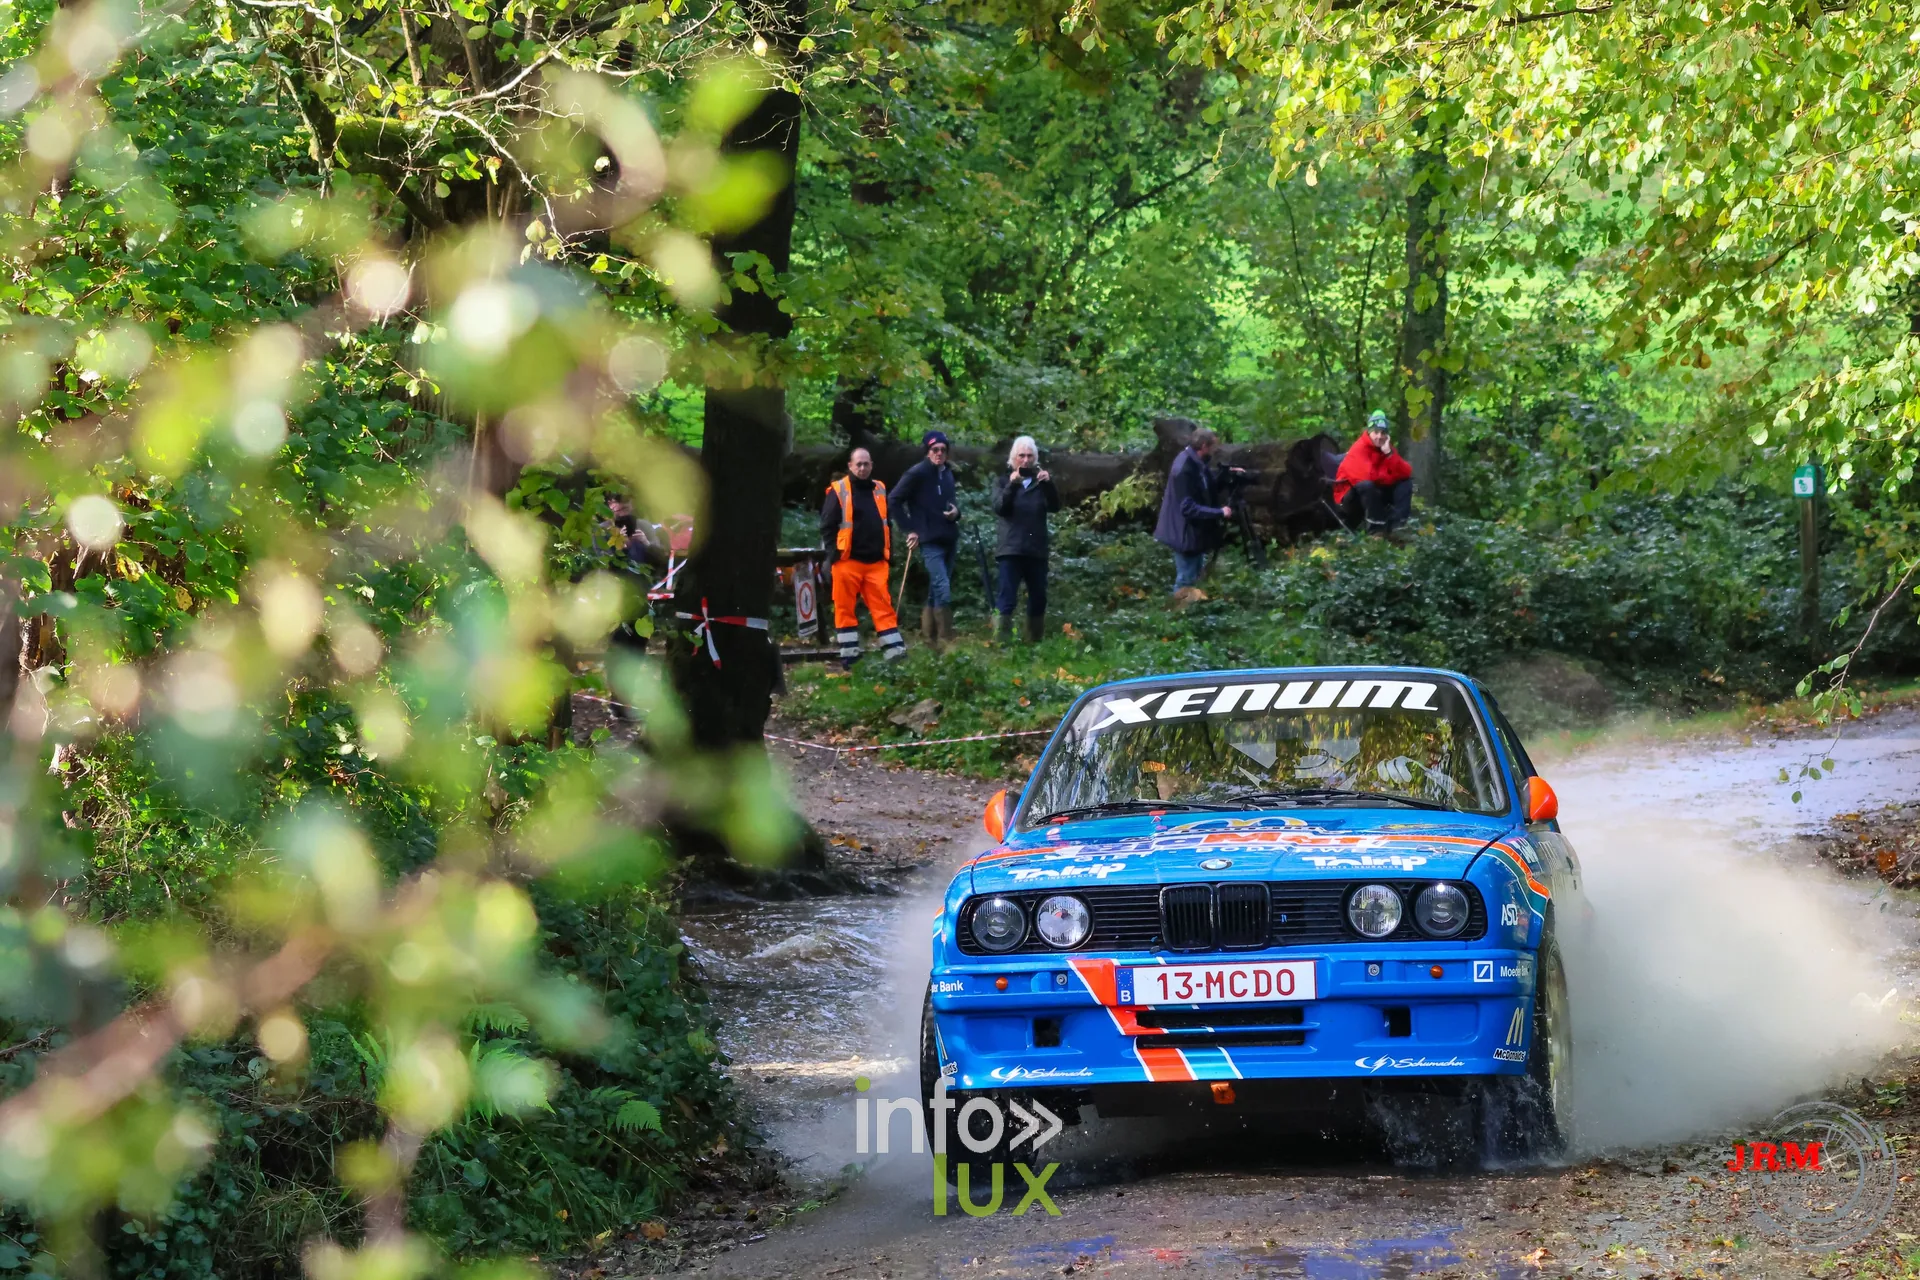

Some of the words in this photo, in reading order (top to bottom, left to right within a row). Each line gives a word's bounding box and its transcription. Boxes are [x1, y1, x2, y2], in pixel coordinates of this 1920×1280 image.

[1088, 680, 1439, 732] XENUM
[939, 979, 964, 993] Bank
[1156, 968, 1296, 1000] 13-MCDO
[1120, 990, 1131, 1002] B
